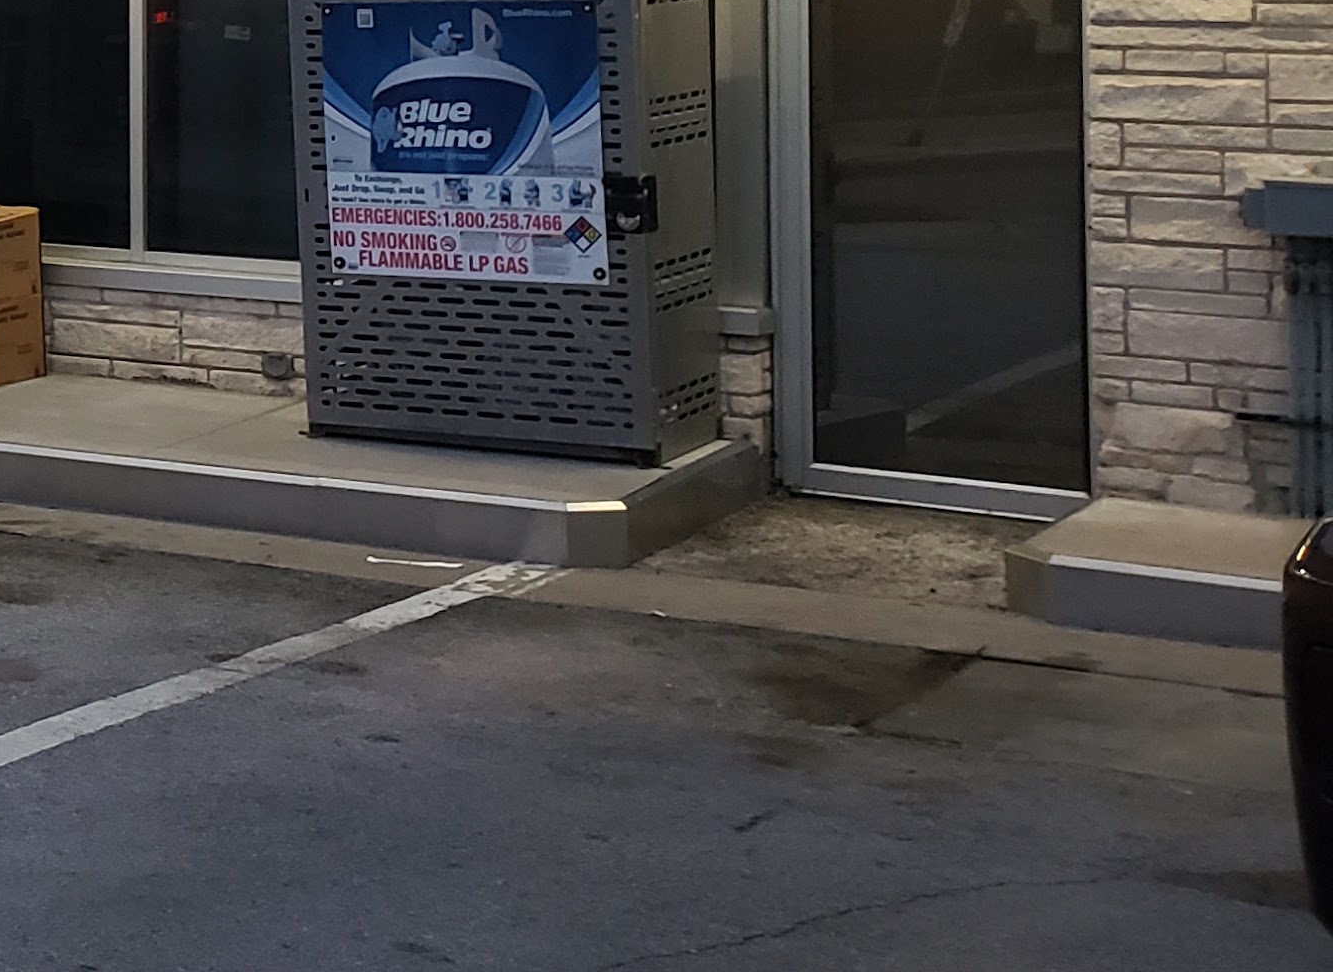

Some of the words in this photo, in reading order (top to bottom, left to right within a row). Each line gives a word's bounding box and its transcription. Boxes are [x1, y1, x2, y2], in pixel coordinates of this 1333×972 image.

[399, 98, 472, 124] Blue
[393, 124, 492, 149] Rhino
[485, 182, 498, 200] 2
[551, 183, 564, 202] 3
[333, 230, 356, 247] NO
[360, 231, 438, 251] SMOKING
[359, 249, 464, 272] FLAMMABLE
[469, 255, 489, 273] LP
[494, 256, 529, 274] GAS
